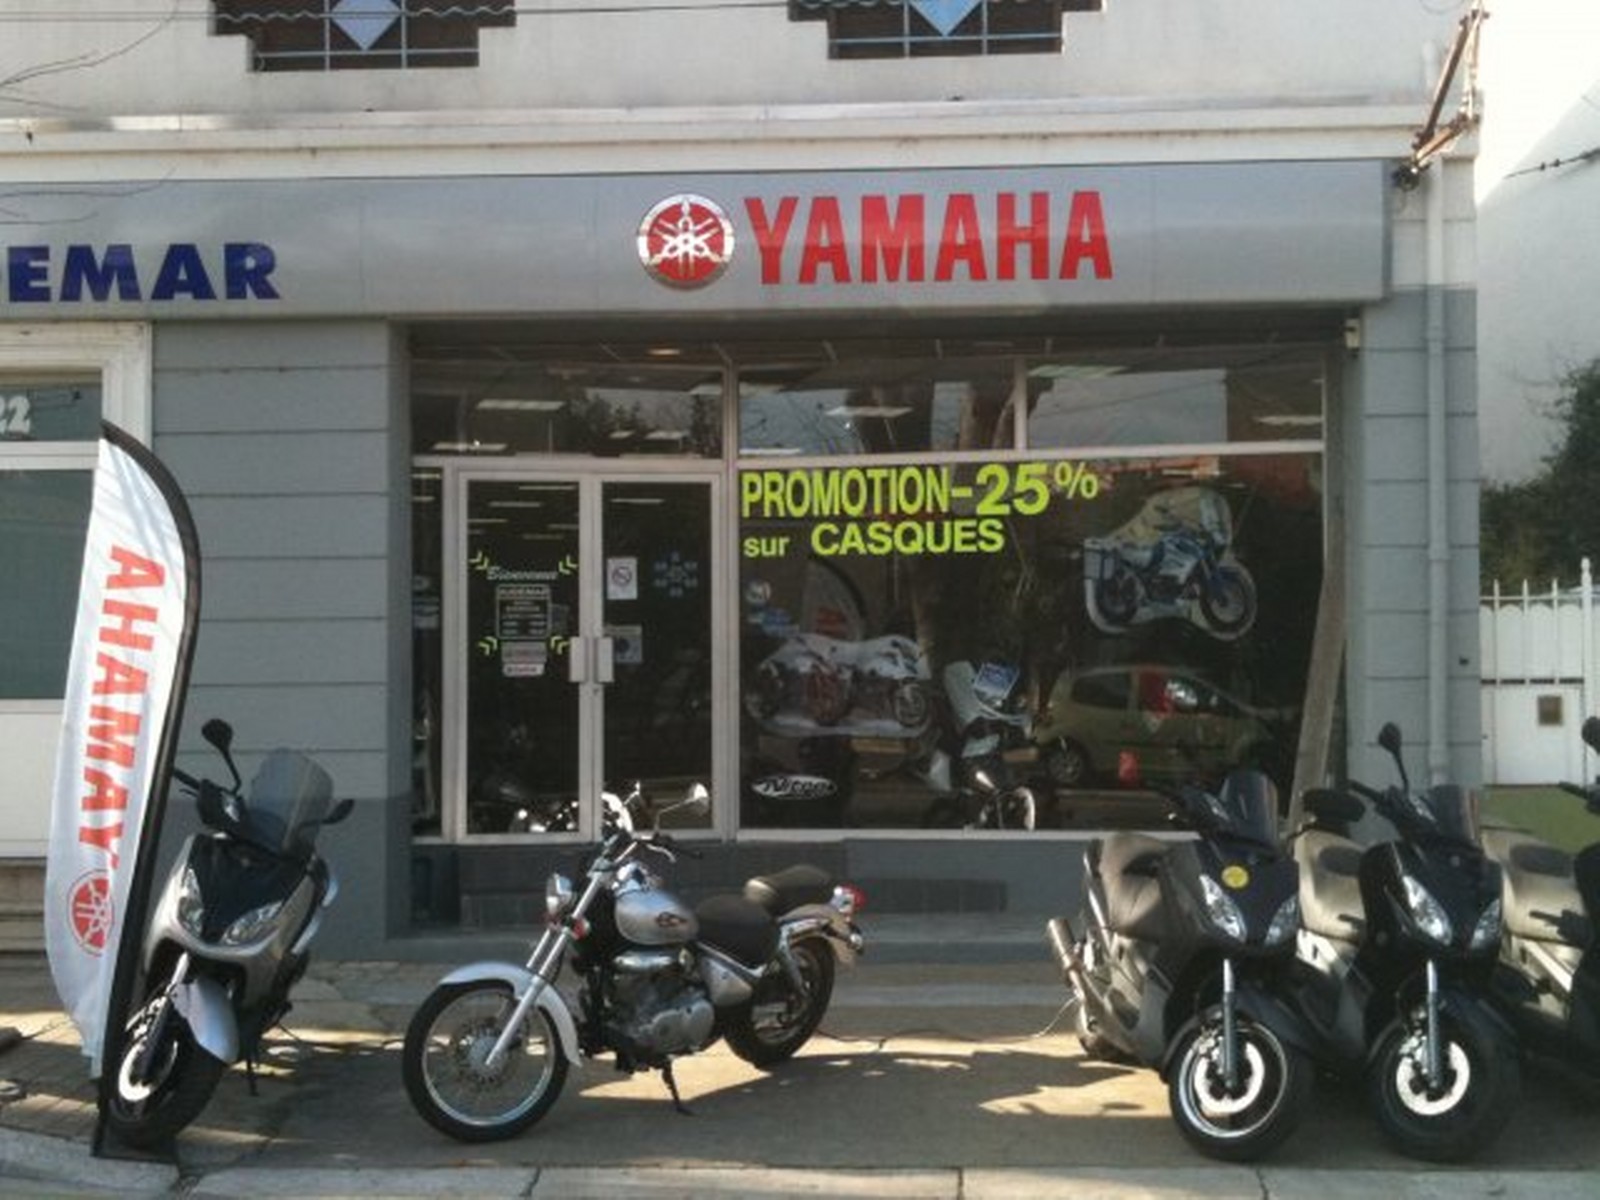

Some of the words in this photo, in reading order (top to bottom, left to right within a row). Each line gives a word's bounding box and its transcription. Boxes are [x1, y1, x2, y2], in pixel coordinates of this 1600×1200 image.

[745, 190, 1113, 285] YAMAHA
[0, 242, 280, 302] EMAR
[741, 467, 948, 517] PROMOTION
[743, 536, 790, 558] sur
[811, 518, 1005, 556] CASQUES
